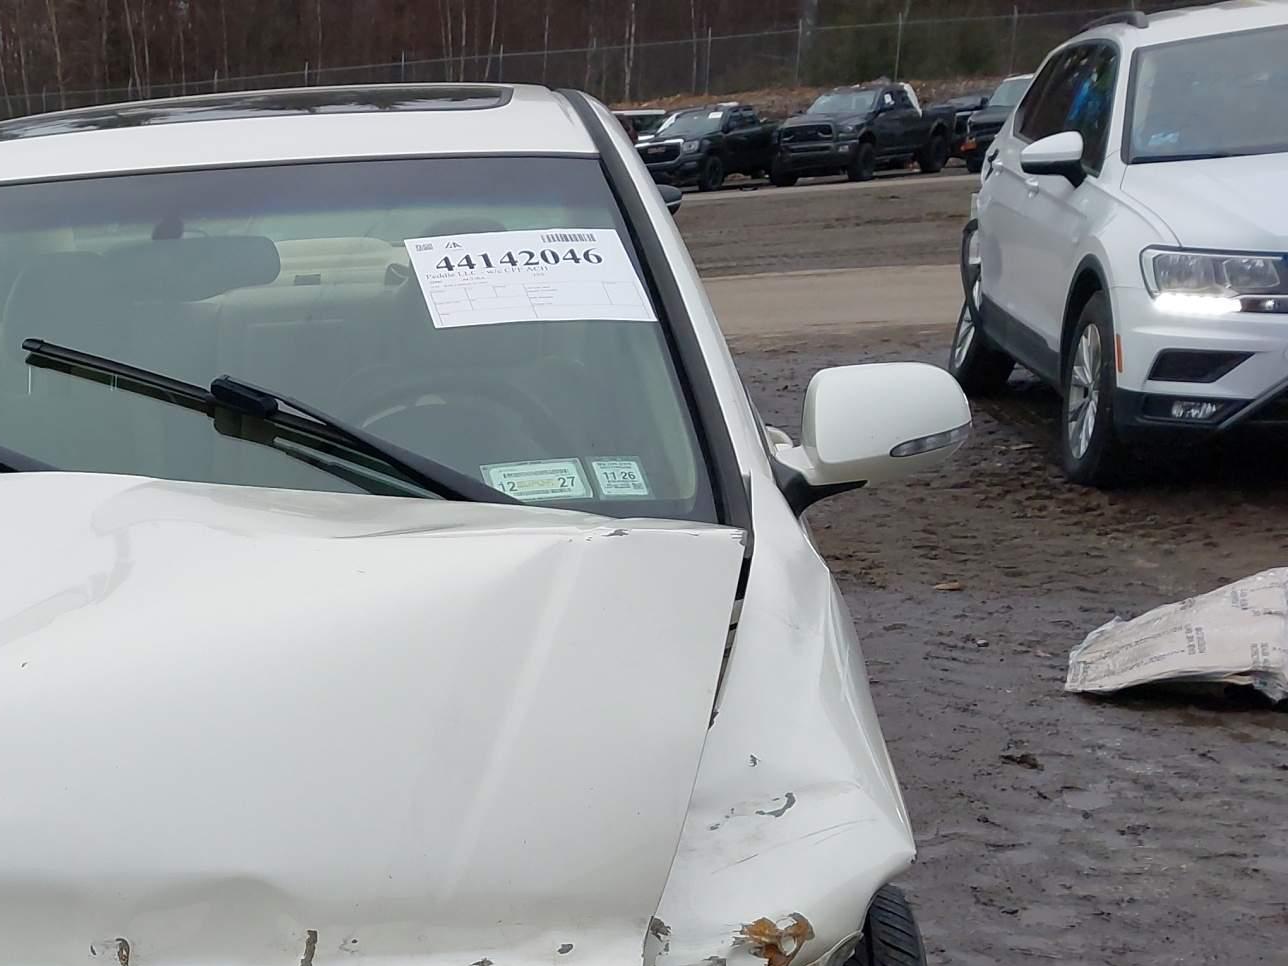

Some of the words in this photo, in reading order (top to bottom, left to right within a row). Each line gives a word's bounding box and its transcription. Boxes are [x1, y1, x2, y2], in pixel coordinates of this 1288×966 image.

[435, 247, 603, 272] 44142046
[602, 471, 617, 480] 11
[620, 471, 636, 480] 26
[499, 481, 518, 493] 12
[558, 476, 576, 489] 27
